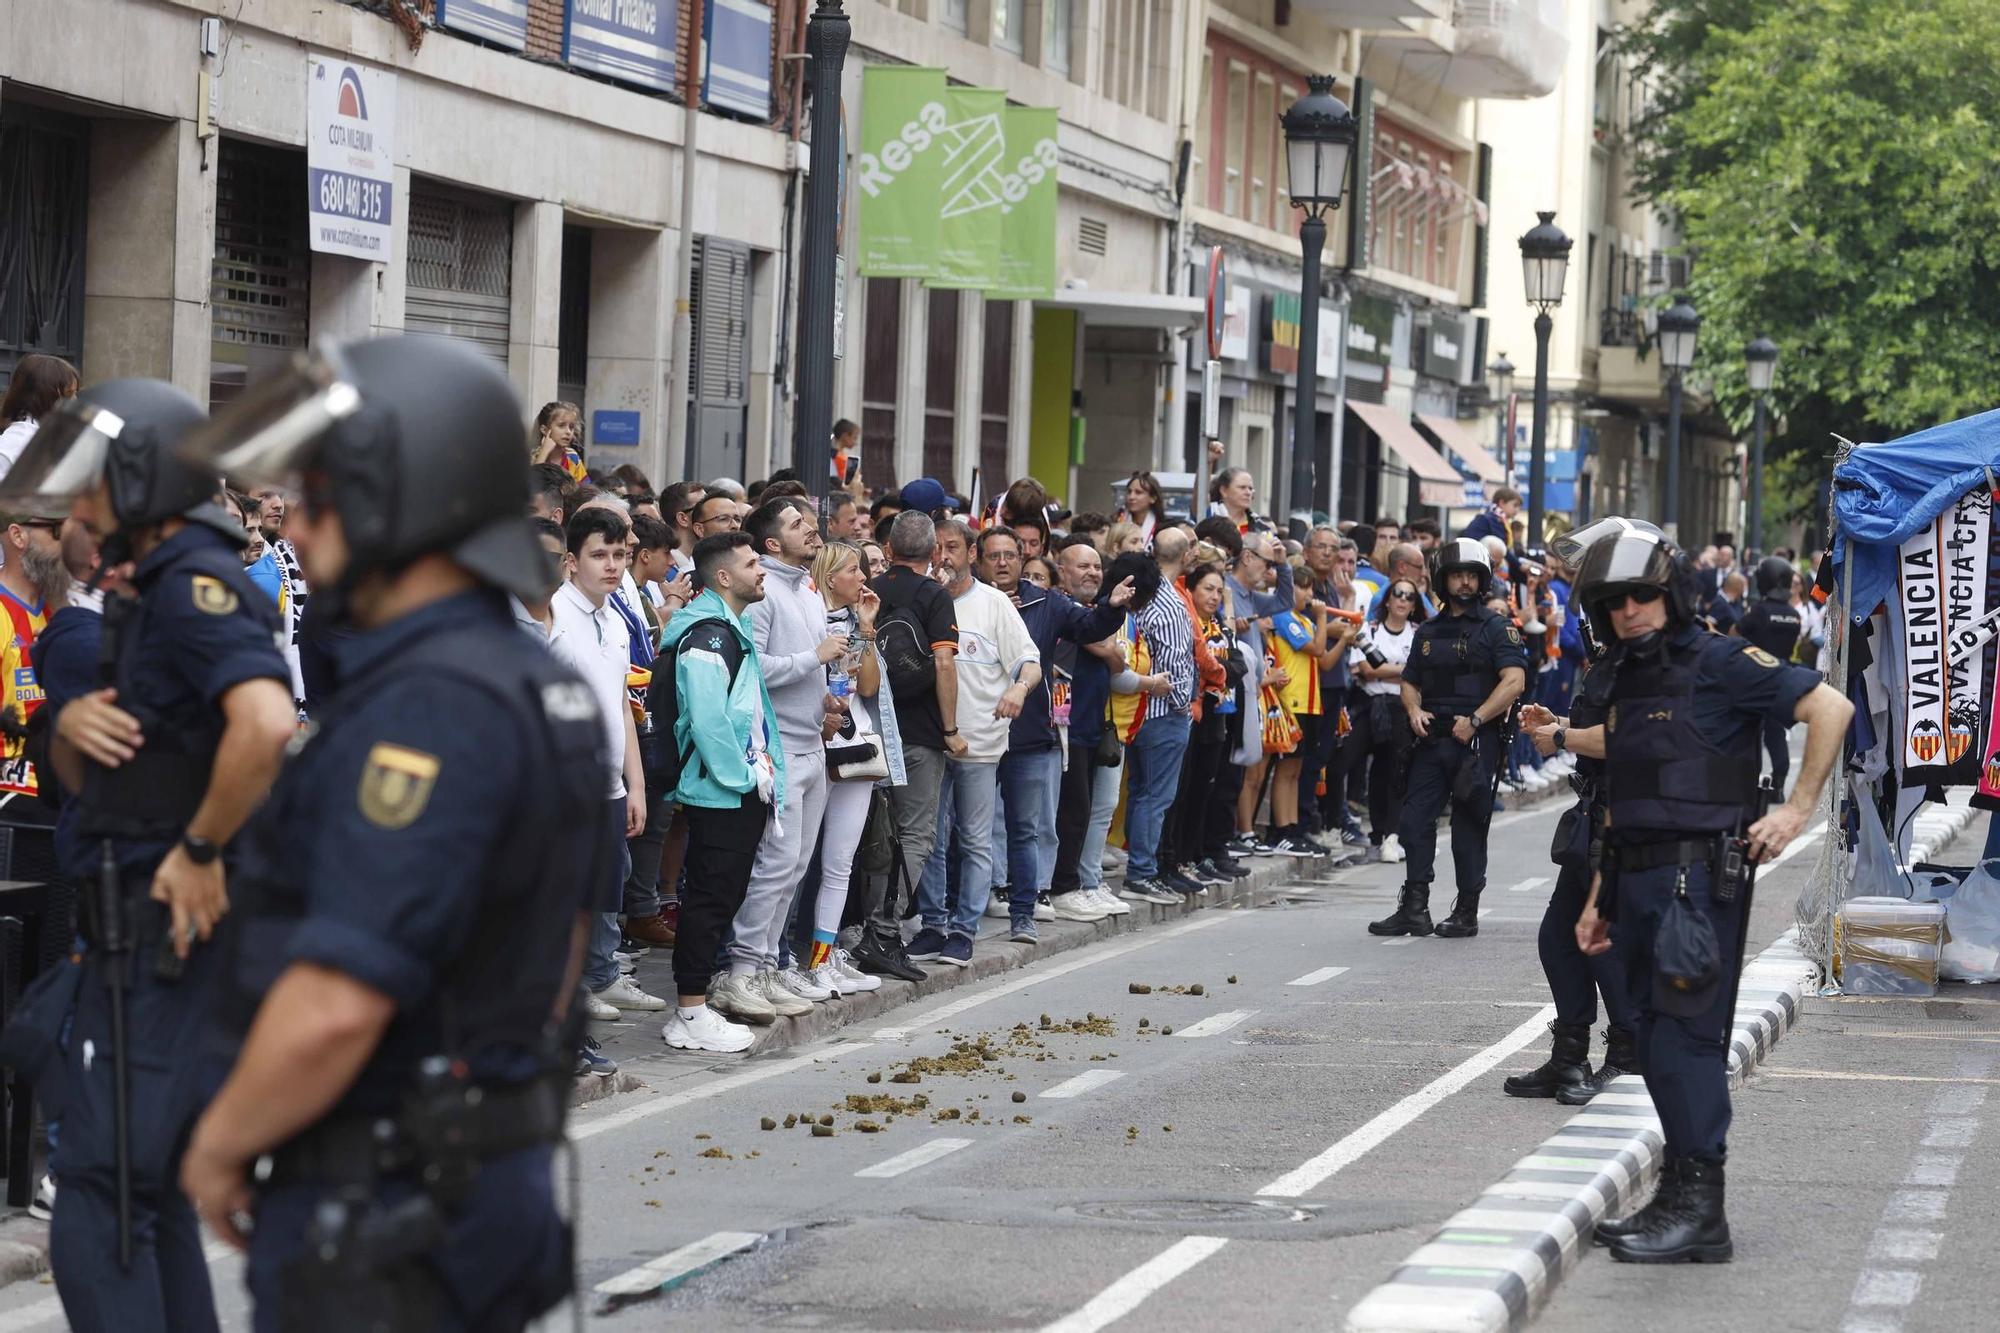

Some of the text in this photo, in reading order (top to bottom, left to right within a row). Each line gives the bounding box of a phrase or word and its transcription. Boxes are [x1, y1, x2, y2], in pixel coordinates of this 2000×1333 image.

[329, 123, 347, 147] COTA
[859, 101, 946, 198] Resa
[1001, 138, 1058, 214] esa
[320, 173, 382, 222] 680 460 315
[1905, 548, 1940, 710] VALENCIA
[1947, 556, 1975, 689] VANCIA
